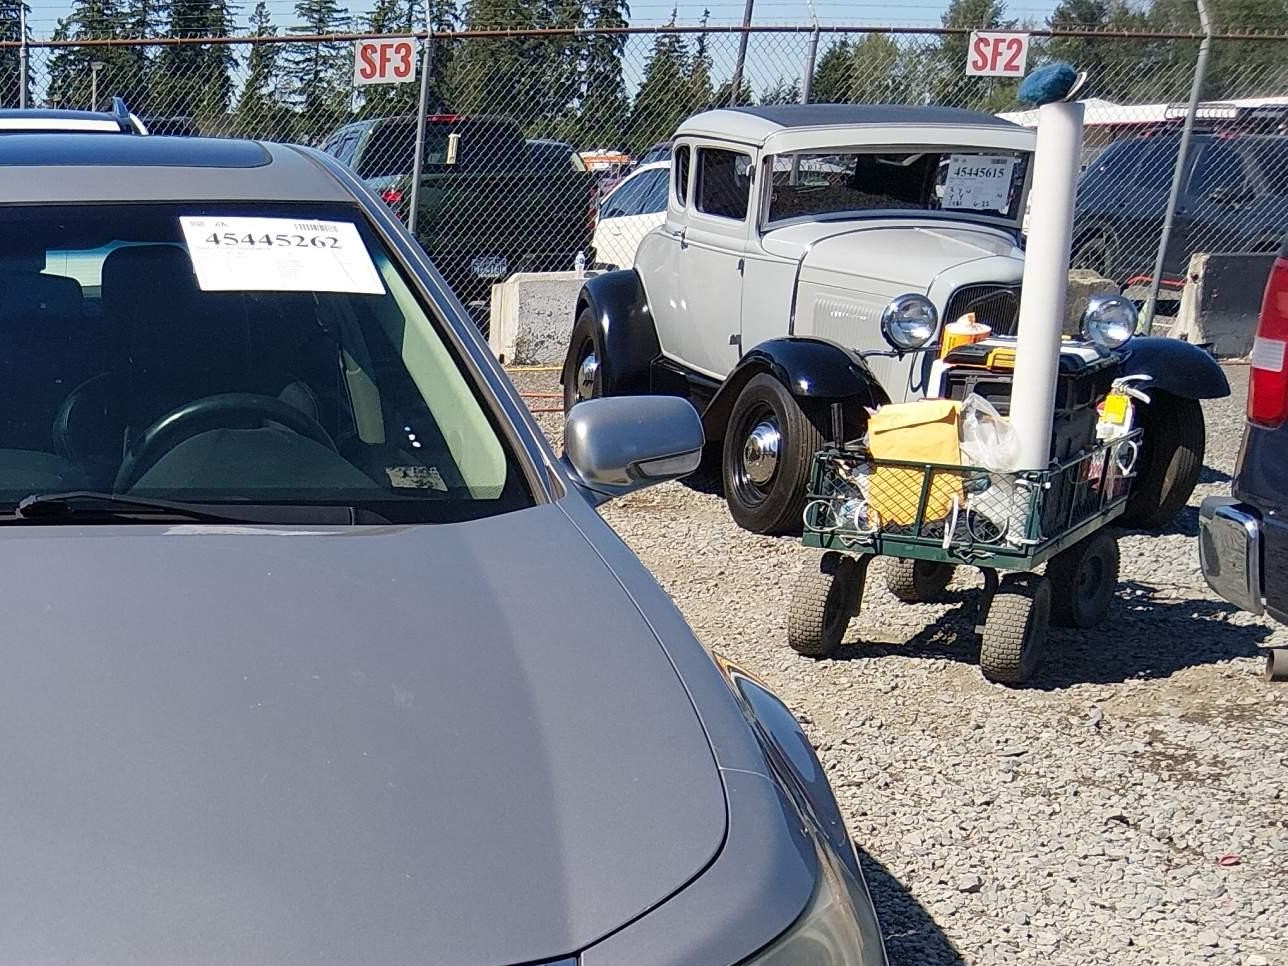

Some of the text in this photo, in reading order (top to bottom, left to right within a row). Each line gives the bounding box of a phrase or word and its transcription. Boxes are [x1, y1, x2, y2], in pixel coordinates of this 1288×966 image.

[360, 43, 412, 79] SF3
[972, 37, 1023, 72] SF2
[954, 167, 1004, 178] 45445615
[205, 232, 343, 249] 45445262
